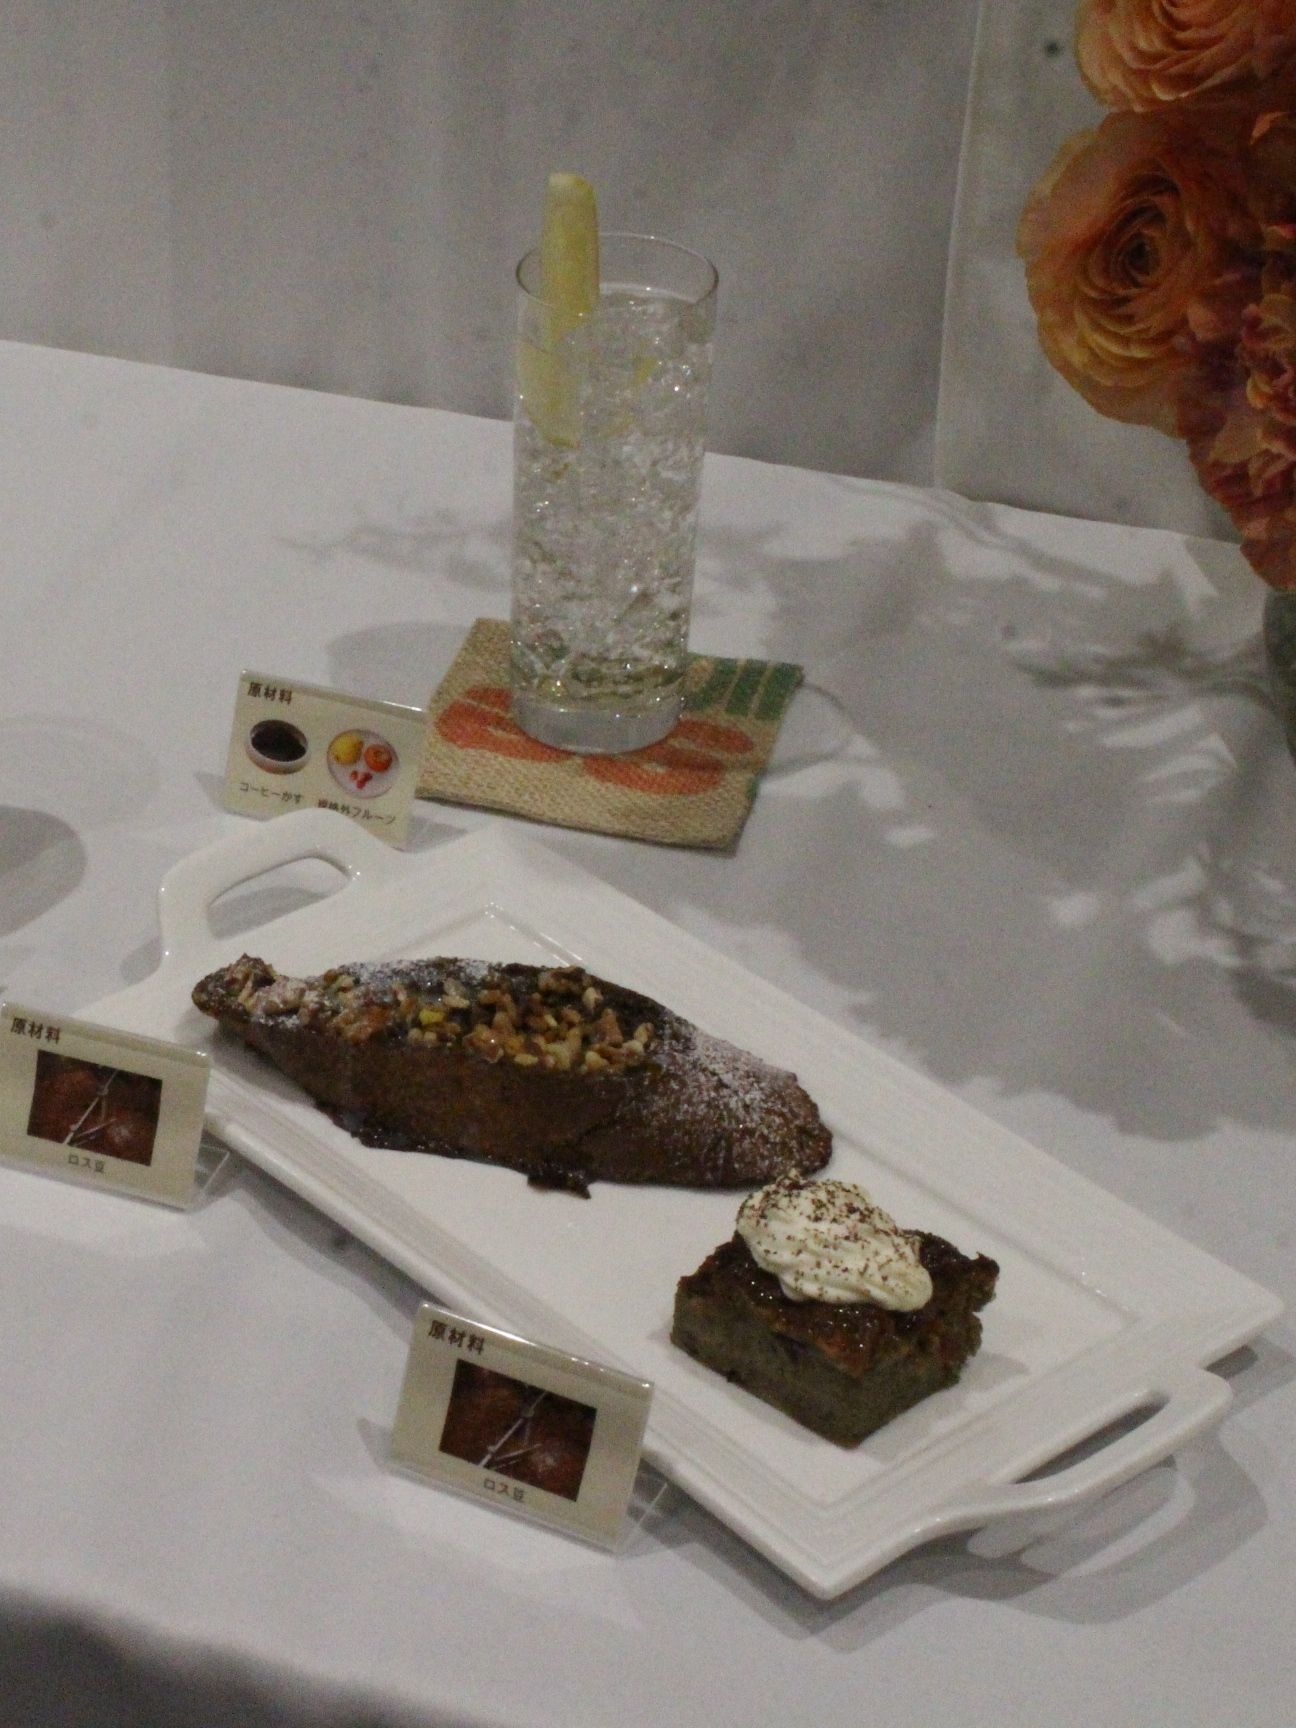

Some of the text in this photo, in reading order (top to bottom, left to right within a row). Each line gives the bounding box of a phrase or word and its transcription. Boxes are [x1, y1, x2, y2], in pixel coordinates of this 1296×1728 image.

[247, 681, 293, 704] 原材料
[239, 782, 302, 804] コーヒーかす
[10, 1016, 61, 1044] 原材料
[68, 1153, 105, 1173] ロス豆
[427, 1319, 486, 1355] 原材料
[484, 1479, 523, 1502] ロス豆
